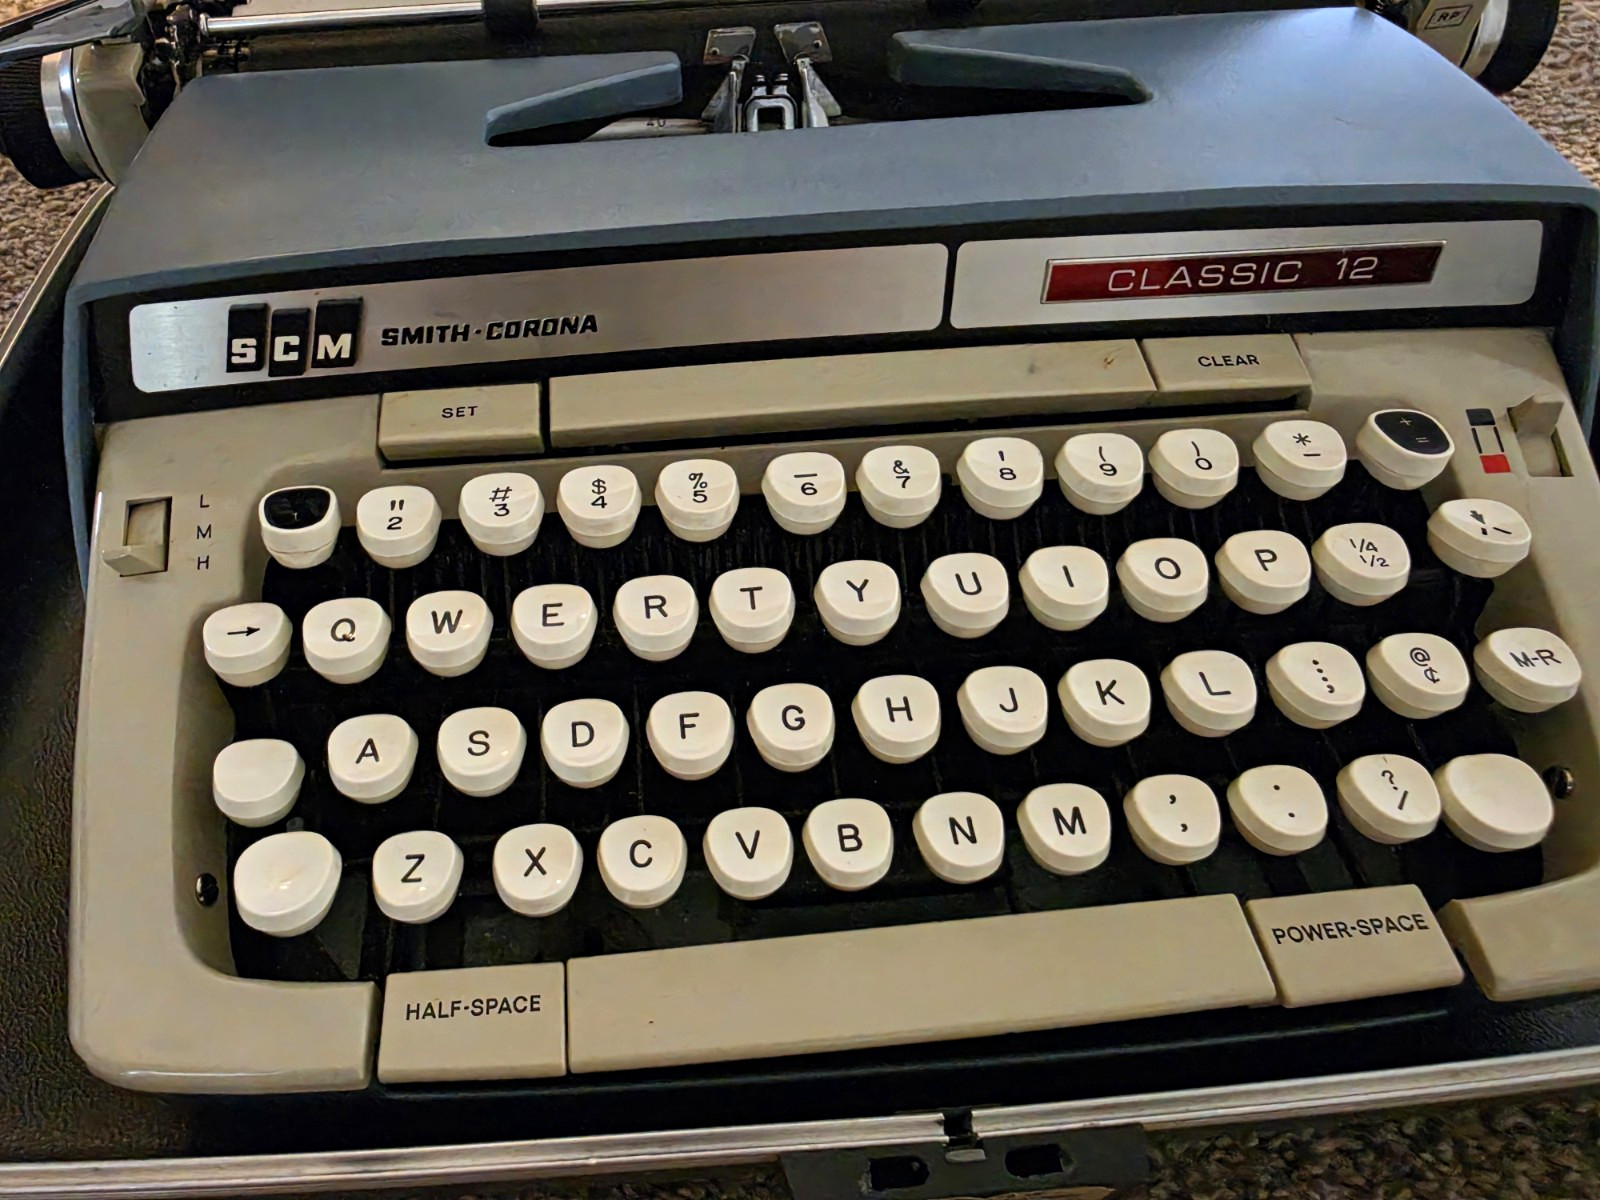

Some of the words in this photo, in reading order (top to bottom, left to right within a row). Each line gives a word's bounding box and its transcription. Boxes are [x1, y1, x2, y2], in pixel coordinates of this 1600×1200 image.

[1107, 260, 1303, 293] CLASSIC
[1337, 257, 1377, 279] 12
[231, 331, 352, 364] SCM
[1198, 355, 1259, 366] CLEAR
[442, 406, 477, 418] SET
[893, 460, 909, 474] &
[1000, 468, 1016, 480] 8
[1100, 464, 1117, 476] 9
[592, 479, 606, 495] $
[689, 473, 707, 489] %
[801, 483, 817, 495] 6
[896, 476, 910, 488] 7
[200, 495, 209, 508] L
[489, 487, 512, 502] #
[591, 496, 607, 508] 4
[693, 490, 707, 503] 5
[494, 504, 509, 516] 3
[197, 524, 211, 539] M
[387, 517, 402, 530] 2
[198, 556, 209, 570] H
[1155, 558, 1181, 579] O
[1255, 549, 1277, 571] P
[955, 572, 982, 595] U
[1063, 566, 1074, 587] I
[740, 587, 762, 609] T
[847, 579, 868, 602] Y
[543, 603, 564, 626] E
[644, 595, 667, 619] R
[331, 618, 355, 642] Q
[431, 610, 463, 634] W
[1410, 648, 1430, 666] @
[1510, 650, 1561, 667] M-R
[1096, 680, 1124, 705] K
[1199, 672, 1231, 695] L
[886, 696, 913, 722] H
[1000, 688, 1018, 712] J
[680, 713, 699, 739] F
[782, 705, 805, 730] G
[468, 731, 490, 756] S
[572, 721, 594, 747] D
[356, 738, 379, 763] A
[1382, 770, 1398, 790] ?
[949, 816, 977, 844] N
[1053, 807, 1086, 835] M
[736, 830, 760, 859] V
[838, 824, 862, 852] B
[524, 847, 546, 877] X
[630, 840, 652, 868] C
[401, 854, 425, 883] Z
[1272, 914, 1429, 944] POWER-SPACE
[406, 995, 540, 1020] HALF-SPACE
